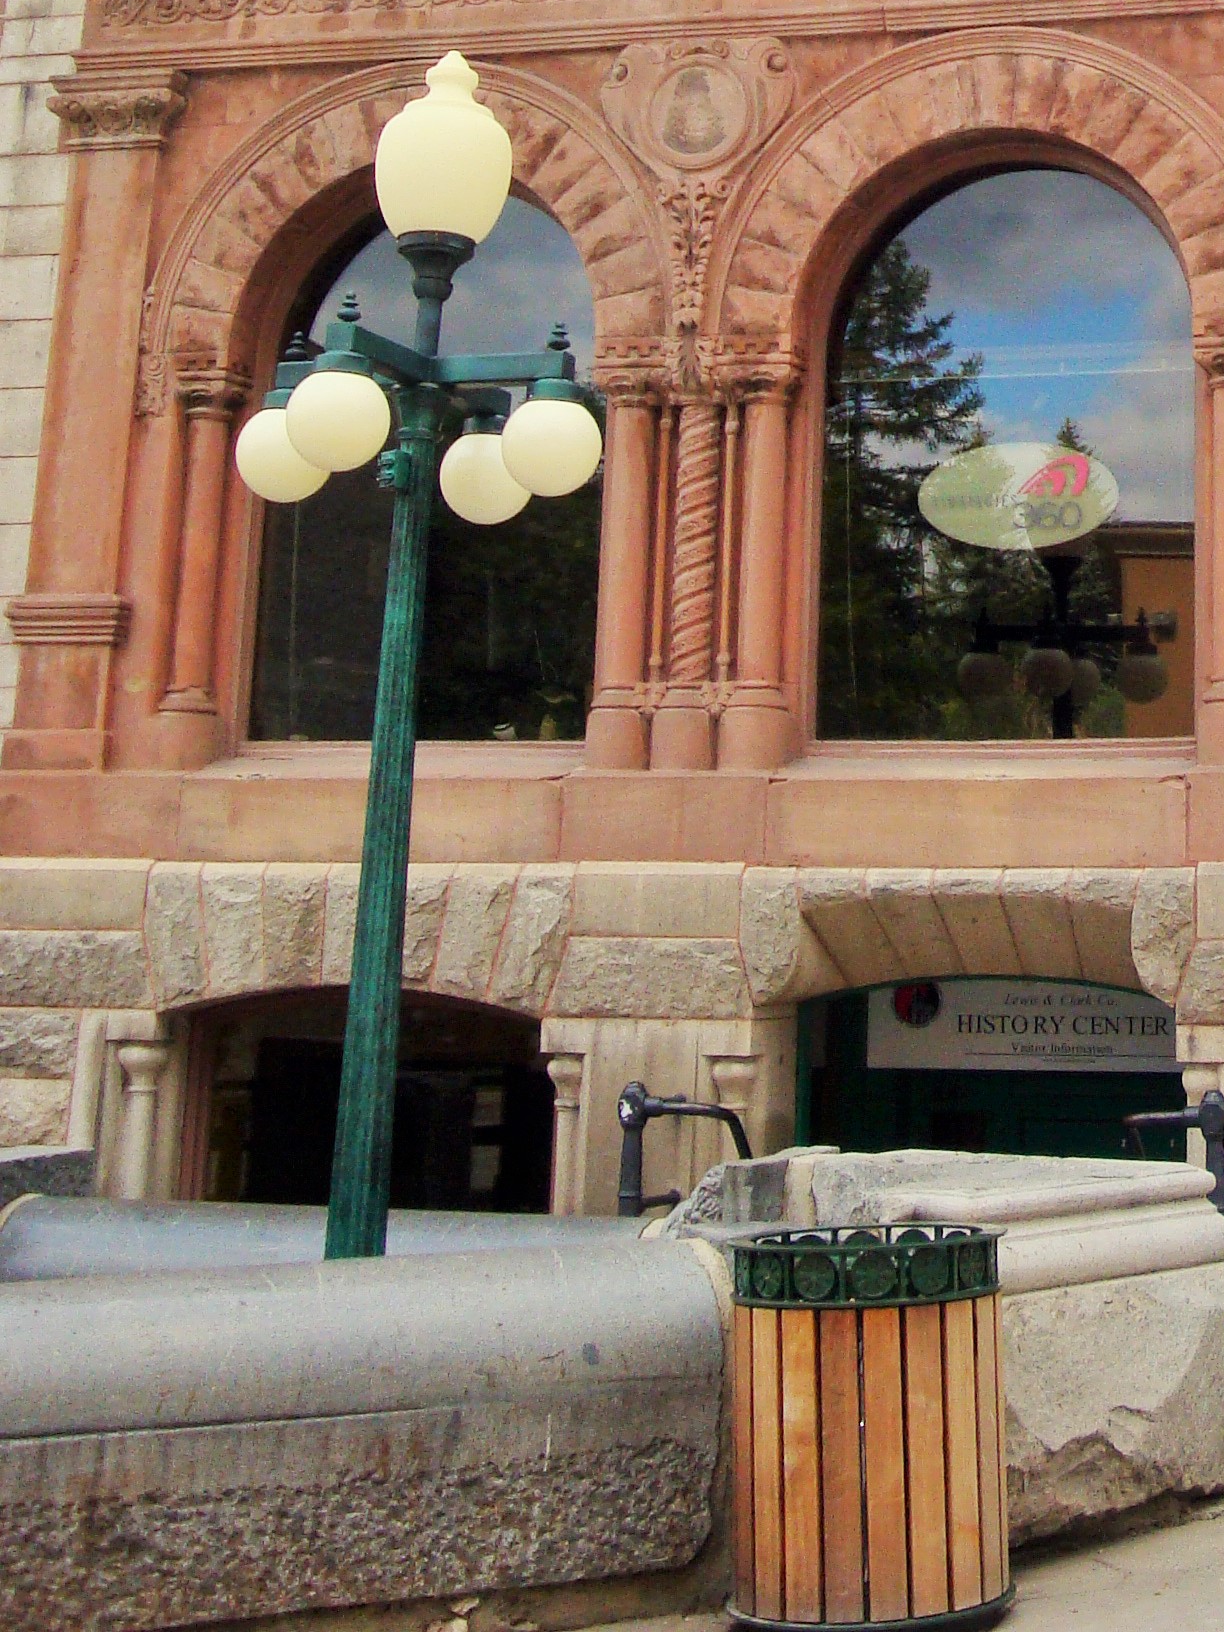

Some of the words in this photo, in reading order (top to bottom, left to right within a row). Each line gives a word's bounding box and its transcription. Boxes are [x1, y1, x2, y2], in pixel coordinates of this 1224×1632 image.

[1012, 500, 1084, 530] 360
[957, 1013, 1066, 1036] HISTORY
[1072, 1015, 1169, 1036] CENTER
